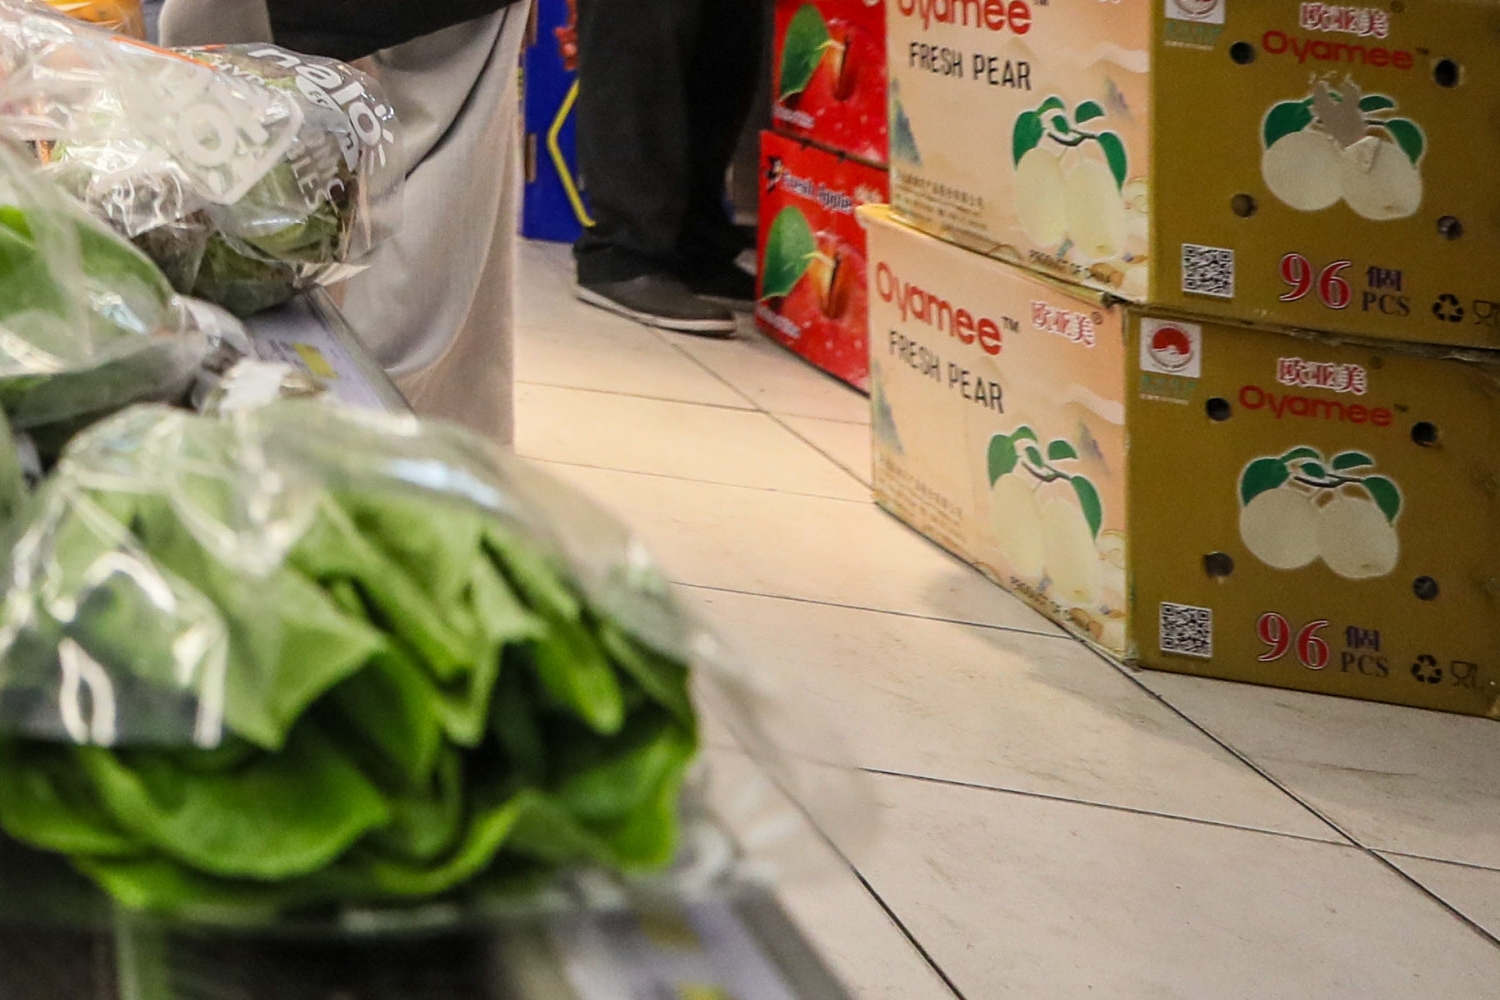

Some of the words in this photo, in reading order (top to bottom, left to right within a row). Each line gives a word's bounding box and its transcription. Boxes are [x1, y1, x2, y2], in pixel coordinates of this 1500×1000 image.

[909, 41, 963, 78] FRESH
[972, 53, 1032, 90] PEAR
[1262, 30, 1415, 70] Oyamee
[1279, 253, 1352, 309] 96
[1361, 290, 1411, 317] PCS
[876, 261, 1002, 356] Oyamee
[889, 330, 941, 382] FRESH
[948, 362, 1004, 414] PEAR
[1238, 385, 1393, 427] Oyamee
[1257, 612, 1330, 670] 96
[1340, 651, 1389, 678] PCS
